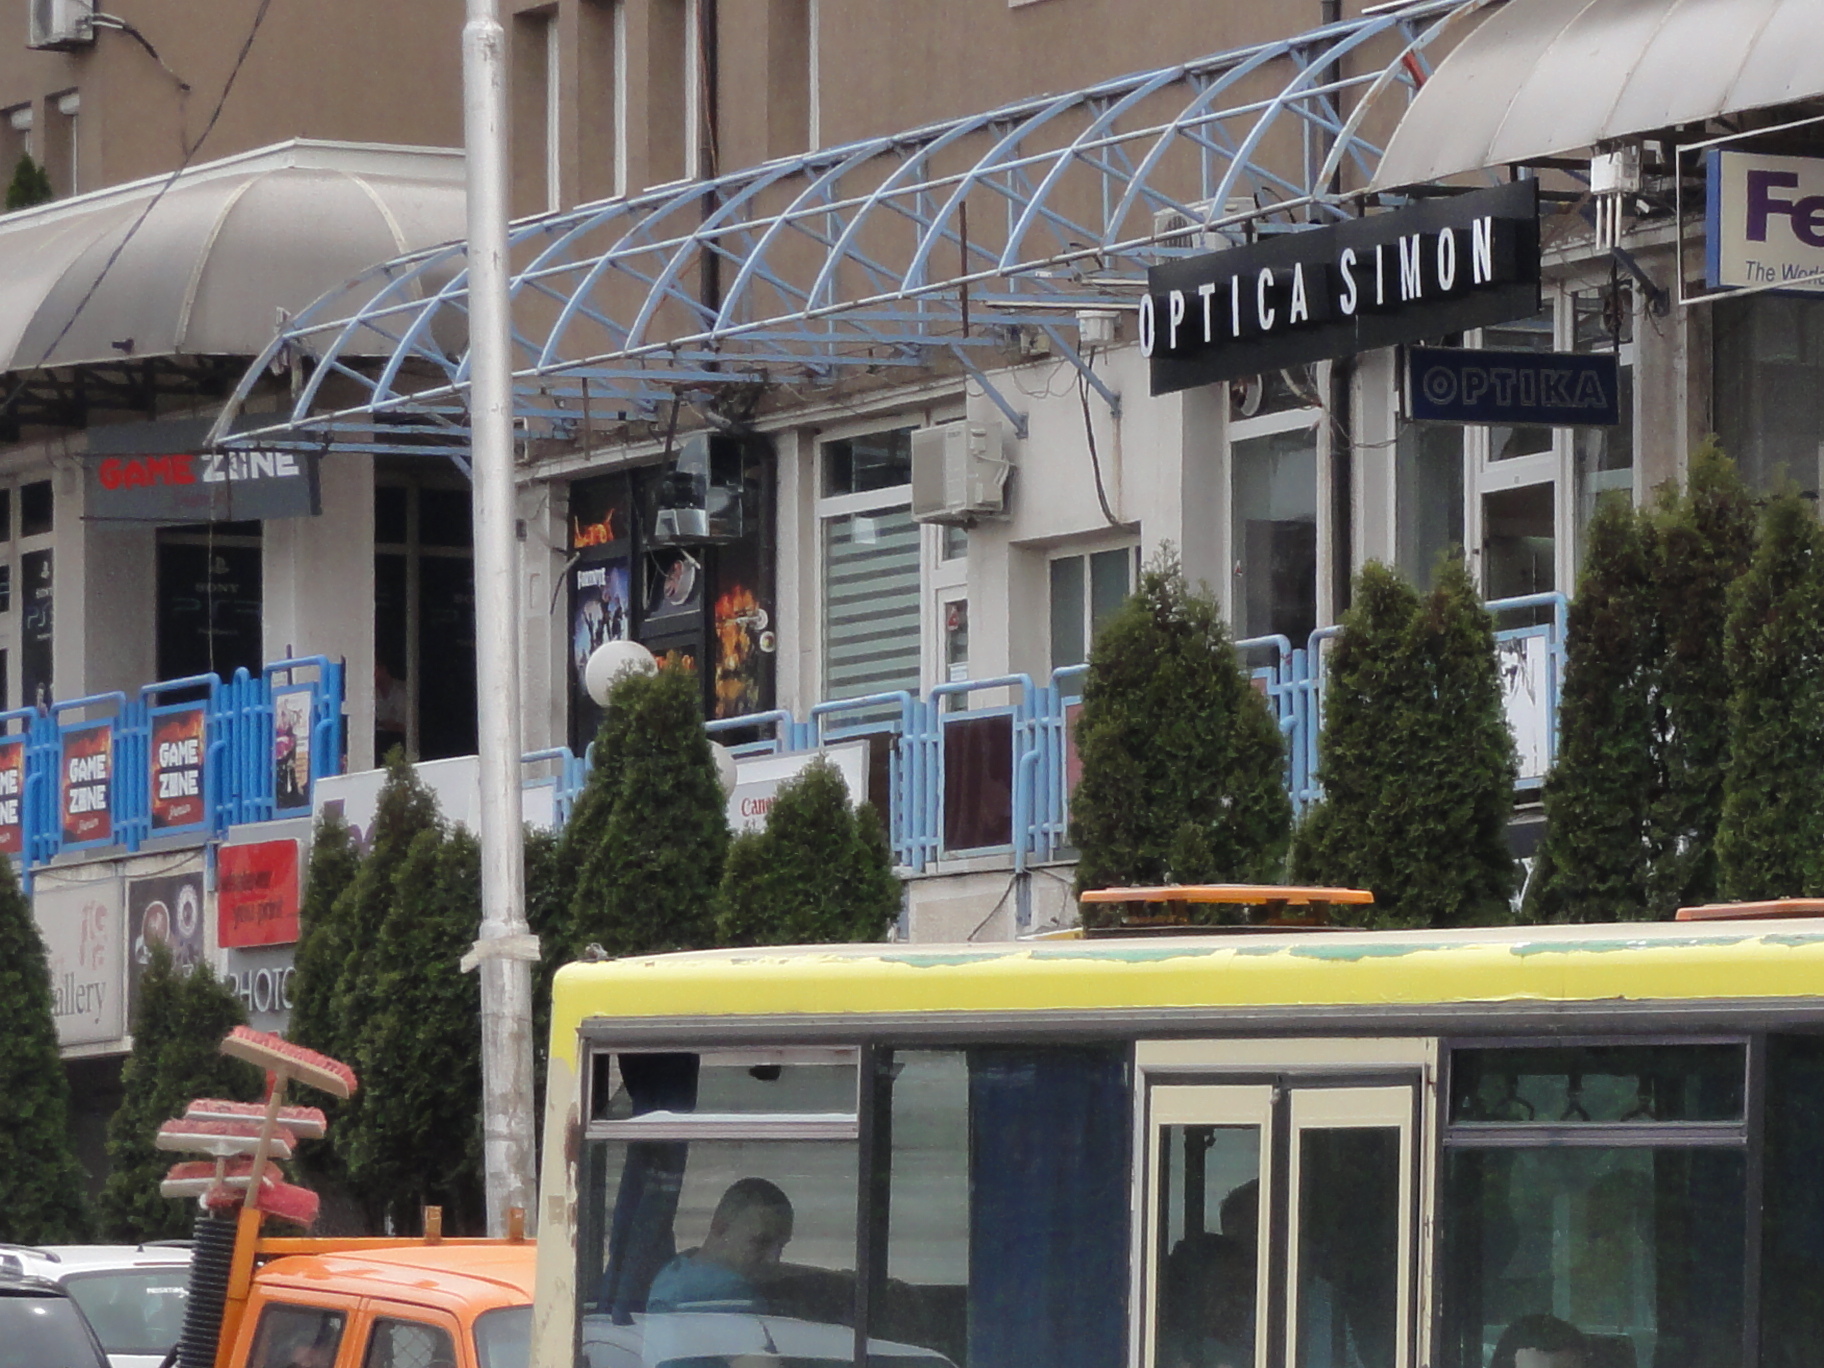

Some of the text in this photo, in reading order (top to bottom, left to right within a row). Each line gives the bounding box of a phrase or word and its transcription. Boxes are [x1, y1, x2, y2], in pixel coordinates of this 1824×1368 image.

[1745, 261, 1775, 282] The
[1138, 216, 1493, 358] OPTICA SIMON
[1423, 366, 1607, 409] OPTIKA
[100, 454, 196, 490] GAME
[69, 754, 106, 783] GAME
[159, 739, 199, 768] GAME
[159, 769, 199, 799] ZONE
[69, 785, 106, 814] ZONE
[50, 971, 106, 1025] allery
